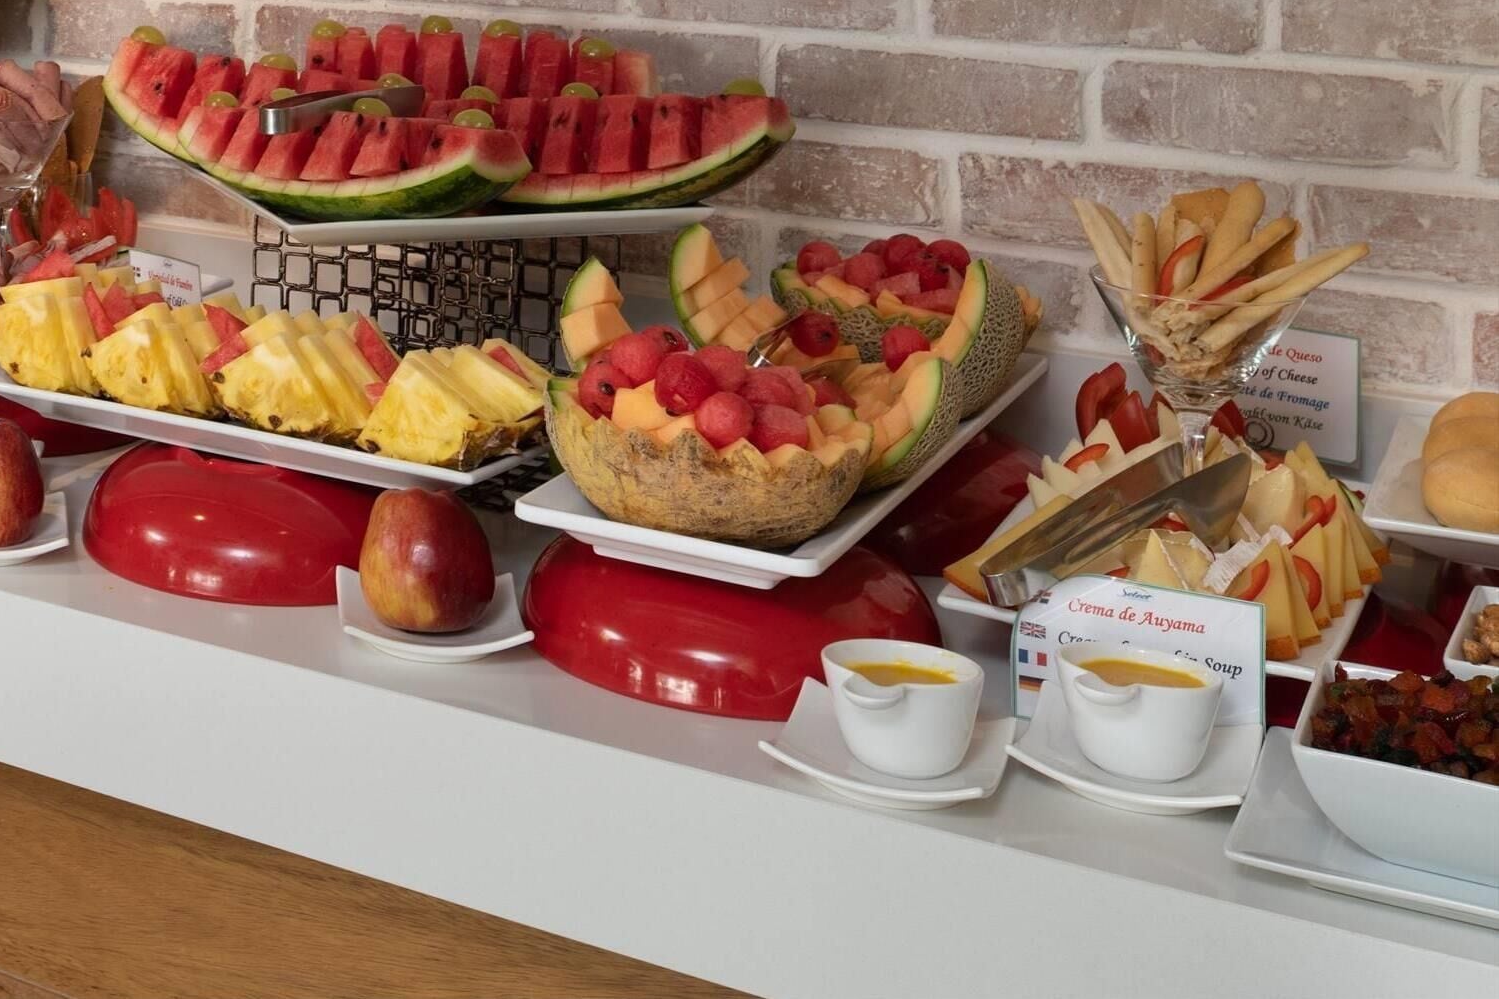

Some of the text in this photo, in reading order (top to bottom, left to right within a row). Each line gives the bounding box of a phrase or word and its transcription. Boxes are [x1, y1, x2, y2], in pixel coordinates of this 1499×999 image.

[1286, 348, 1323, 363] Queso
[1262, 366, 1277, 380] of
[1278, 368, 1318, 385] Cheese
[1259, 386, 1273, 399] de
[1277, 390, 1330, 411] Fromage
[1268, 413, 1289, 424] von
[1293, 414, 1324, 431] Käse
[1068, 598, 1205, 634] Crema de Auyama
[1204, 657, 1243, 680] Soup
